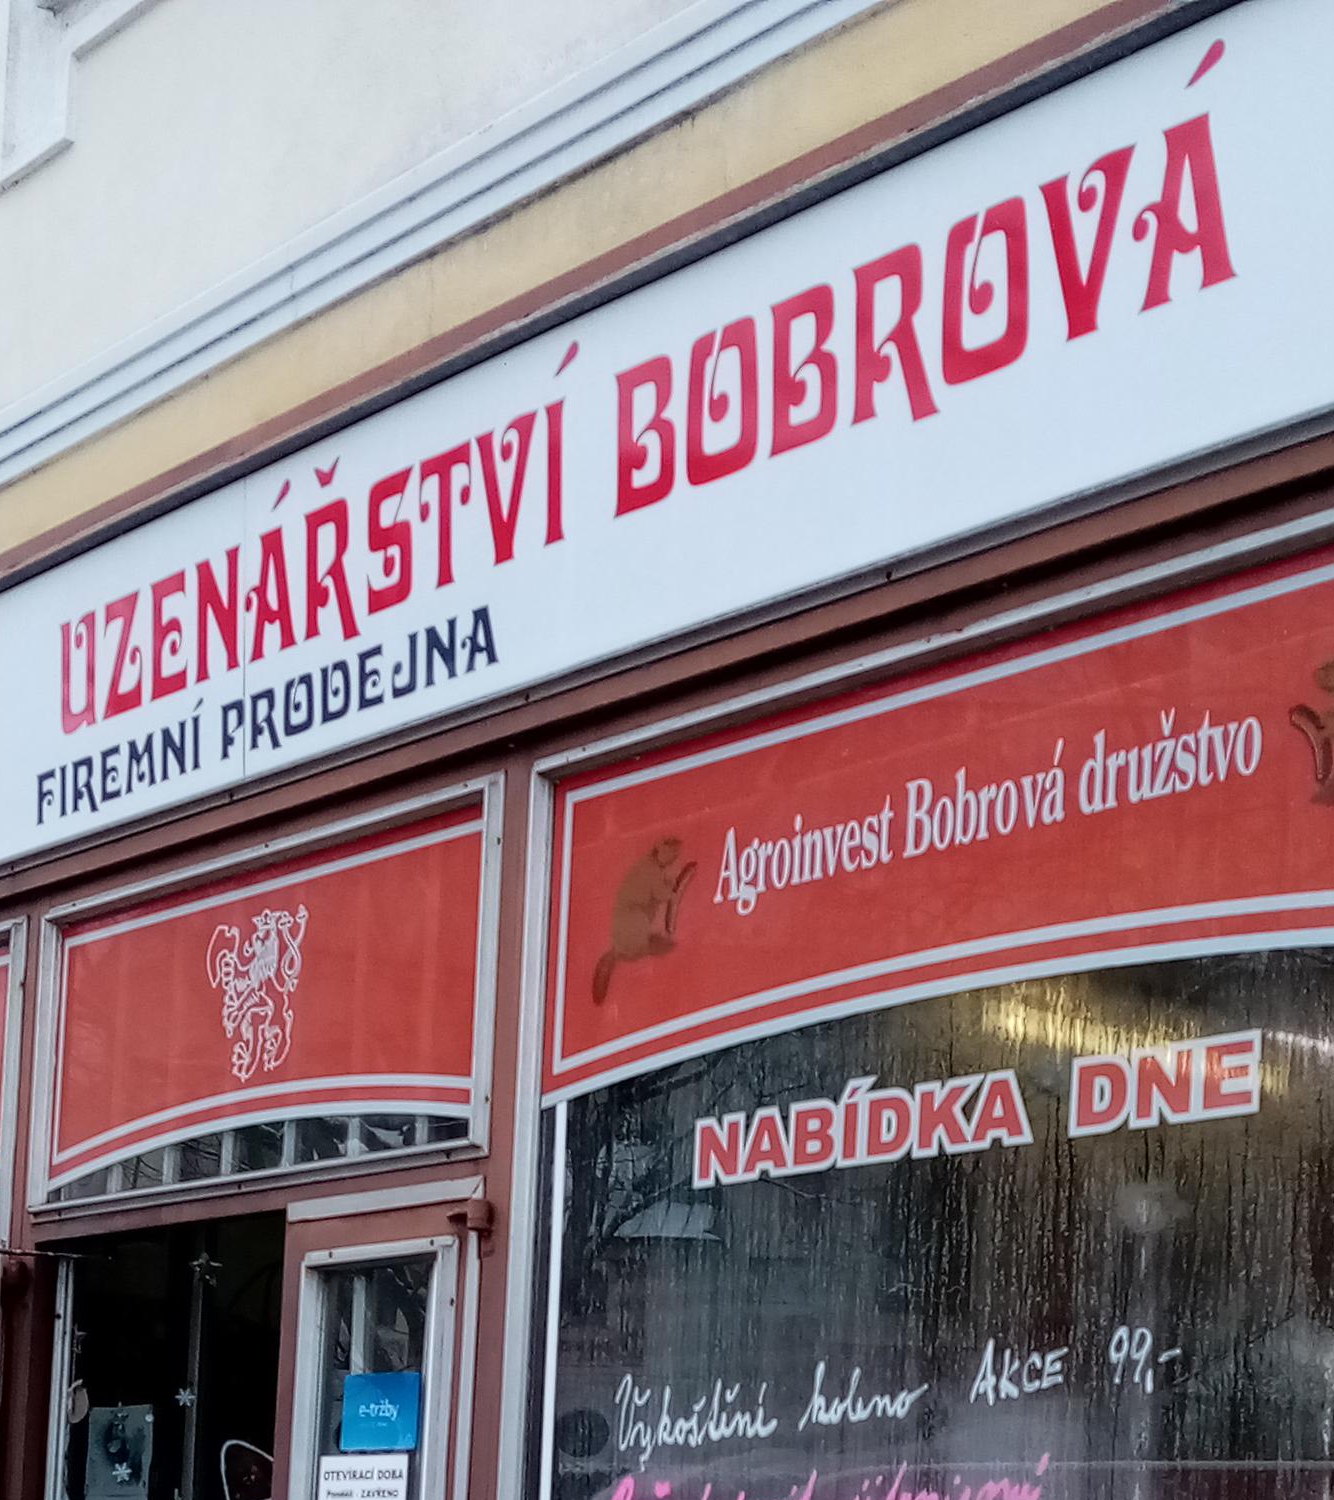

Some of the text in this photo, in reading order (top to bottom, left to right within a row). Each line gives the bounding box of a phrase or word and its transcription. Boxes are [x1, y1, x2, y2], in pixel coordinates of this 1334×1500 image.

[59, 340, 580, 735] UZENÁŘSTVÍ
[614, 38, 1238, 519] BOBROVÁ
[35, 605, 499, 826] FIREMNÍ PRODEJNA
[714, 707, 1263, 915] Agroinvest Bobrová družstvo
[692, 1028, 1263, 1190] NABÍDKA DNE
[798, 1361, 929, 1431] koleno
[969, 1338, 1069, 1406] AKCE
